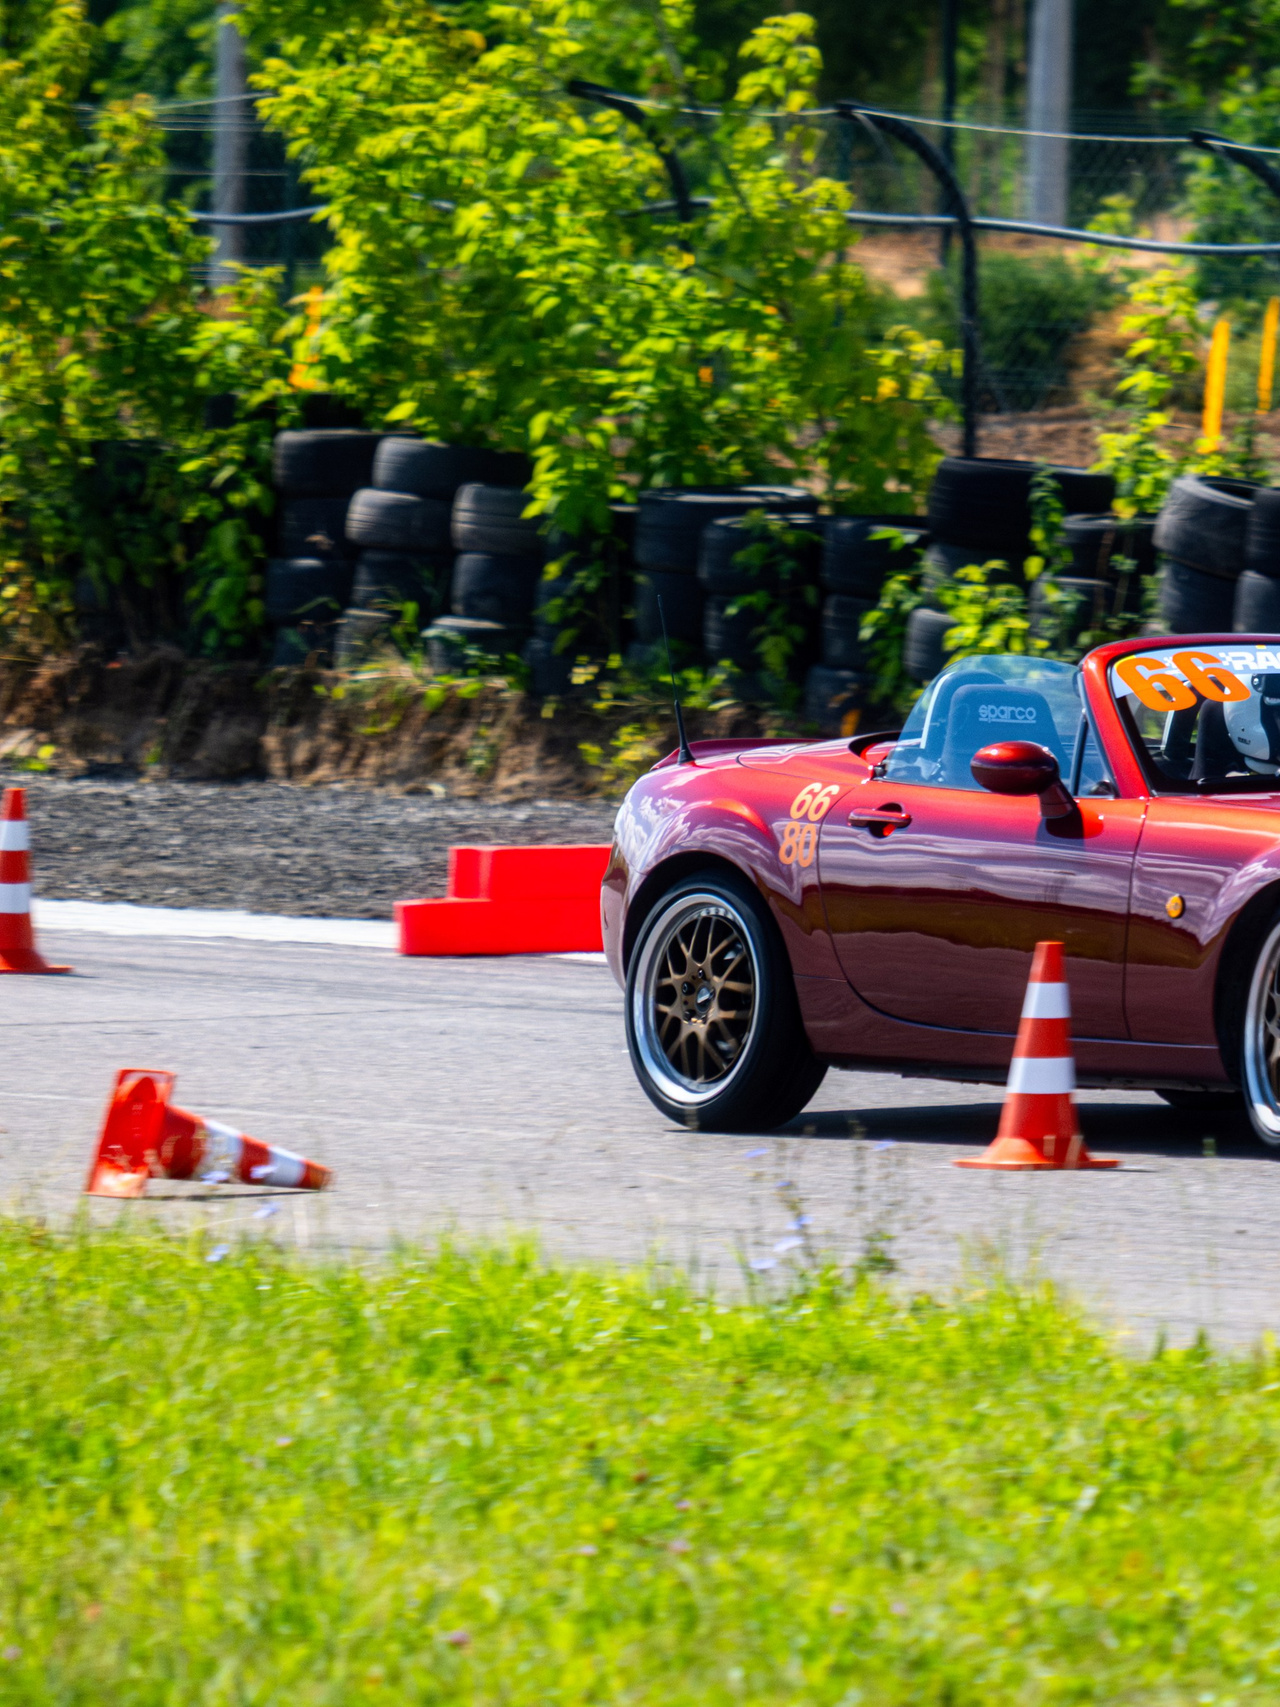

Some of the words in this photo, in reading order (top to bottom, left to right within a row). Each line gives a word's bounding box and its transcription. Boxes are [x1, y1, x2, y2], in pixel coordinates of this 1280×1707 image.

[1116, 651, 1251, 711] 66
[979, 704, 1036, 722] sparco
[790, 782, 840, 822] 66
[779, 821, 817, 868] 80
